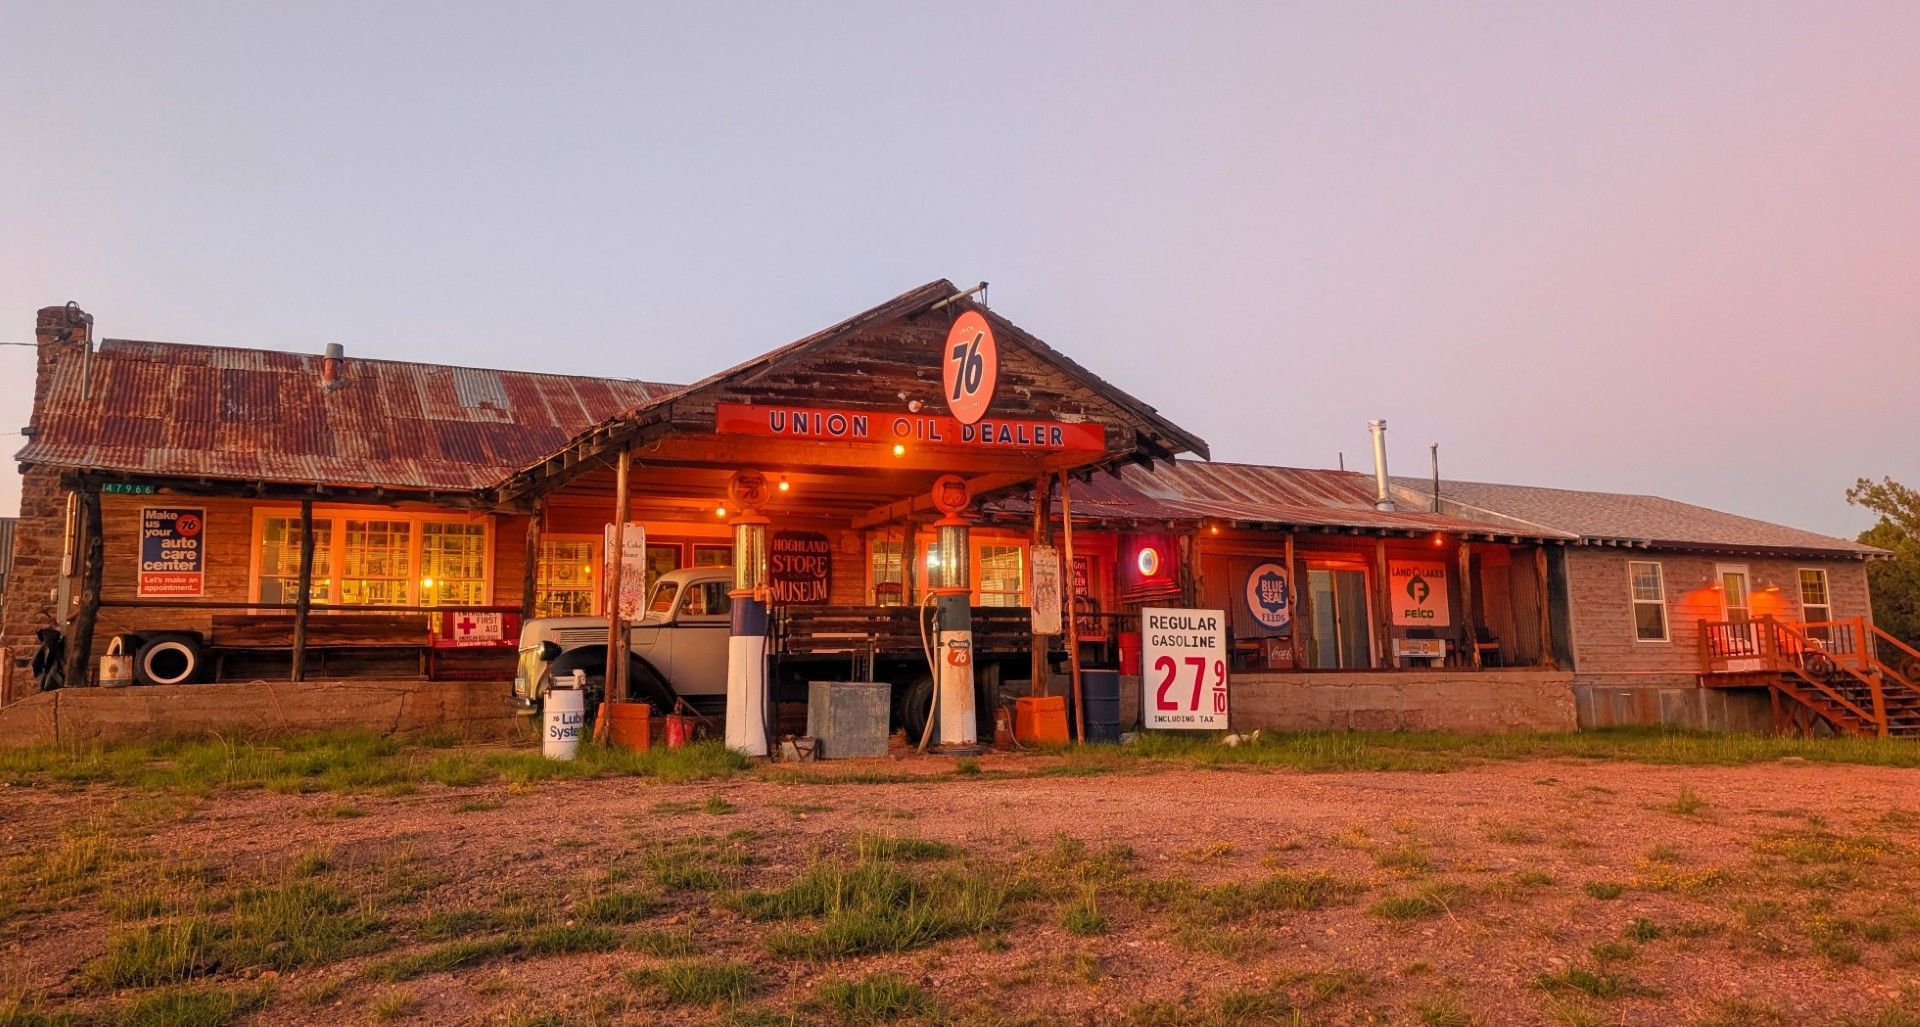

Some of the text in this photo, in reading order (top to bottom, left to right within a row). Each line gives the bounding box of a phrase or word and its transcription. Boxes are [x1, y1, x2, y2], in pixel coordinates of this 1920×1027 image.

[952, 329, 985, 402] 76
[769, 410, 1064, 447] UNION OIL DEALER
[145, 510, 178, 520] Make
[145, 521, 160, 529] us
[181, 520, 196, 531] 76
[145, 529, 172, 538] your
[161, 538, 197, 549] auto
[161, 550, 197, 560] care
[143, 560, 196, 571] center
[773, 555, 828, 578] STORE
[1391, 567, 1412, 577] LAND
[1422, 568, 1445, 578] LAKES
[770, 578, 828, 602] MUSEUM
[1261, 580, 1284, 592] BLUE
[1262, 592, 1284, 603] SEAL
[476, 616, 498, 625] FIRST
[1150, 615, 1217, 630] REGULAR
[1261, 613, 1286, 622] FEEDS
[485, 625, 498, 633] AID
[1152, 635, 1216, 648] GASOLINE
[953, 648, 967, 663] 76
[1154, 655, 1206, 711] 27
[1154, 715, 1214, 723] INCLUDING TAX
[550, 725, 579, 740] Syste
